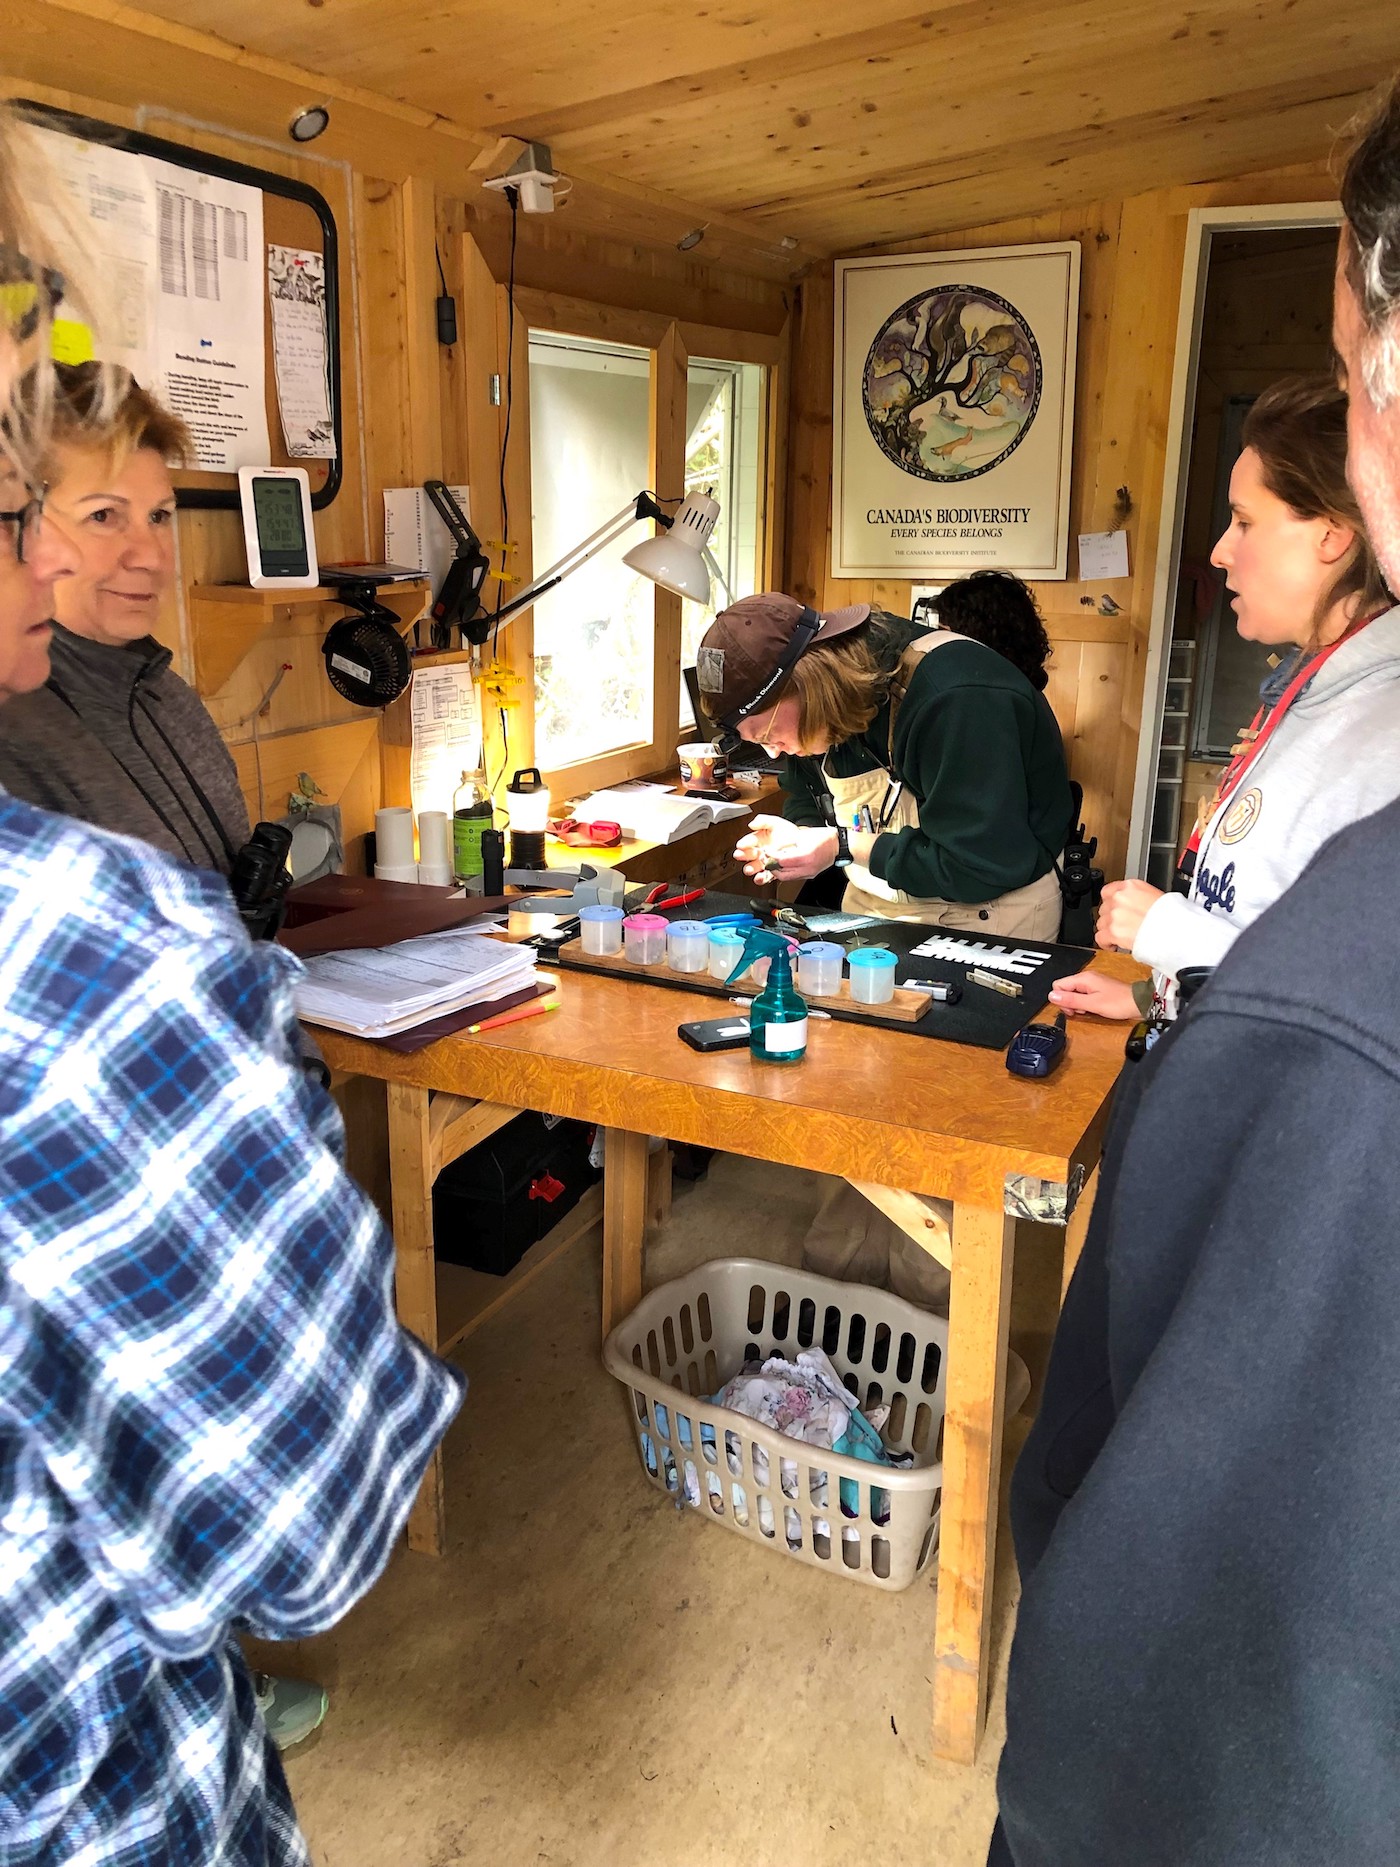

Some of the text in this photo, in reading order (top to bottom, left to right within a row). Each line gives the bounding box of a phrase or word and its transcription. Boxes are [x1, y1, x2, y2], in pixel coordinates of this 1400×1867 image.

[866, 508, 1032, 524] CANADA'S BIODIVERSITY
[890, 528, 1003, 538] EVERY SPECIES BELONGS
[745, 667, 784, 709] Black Diamond
